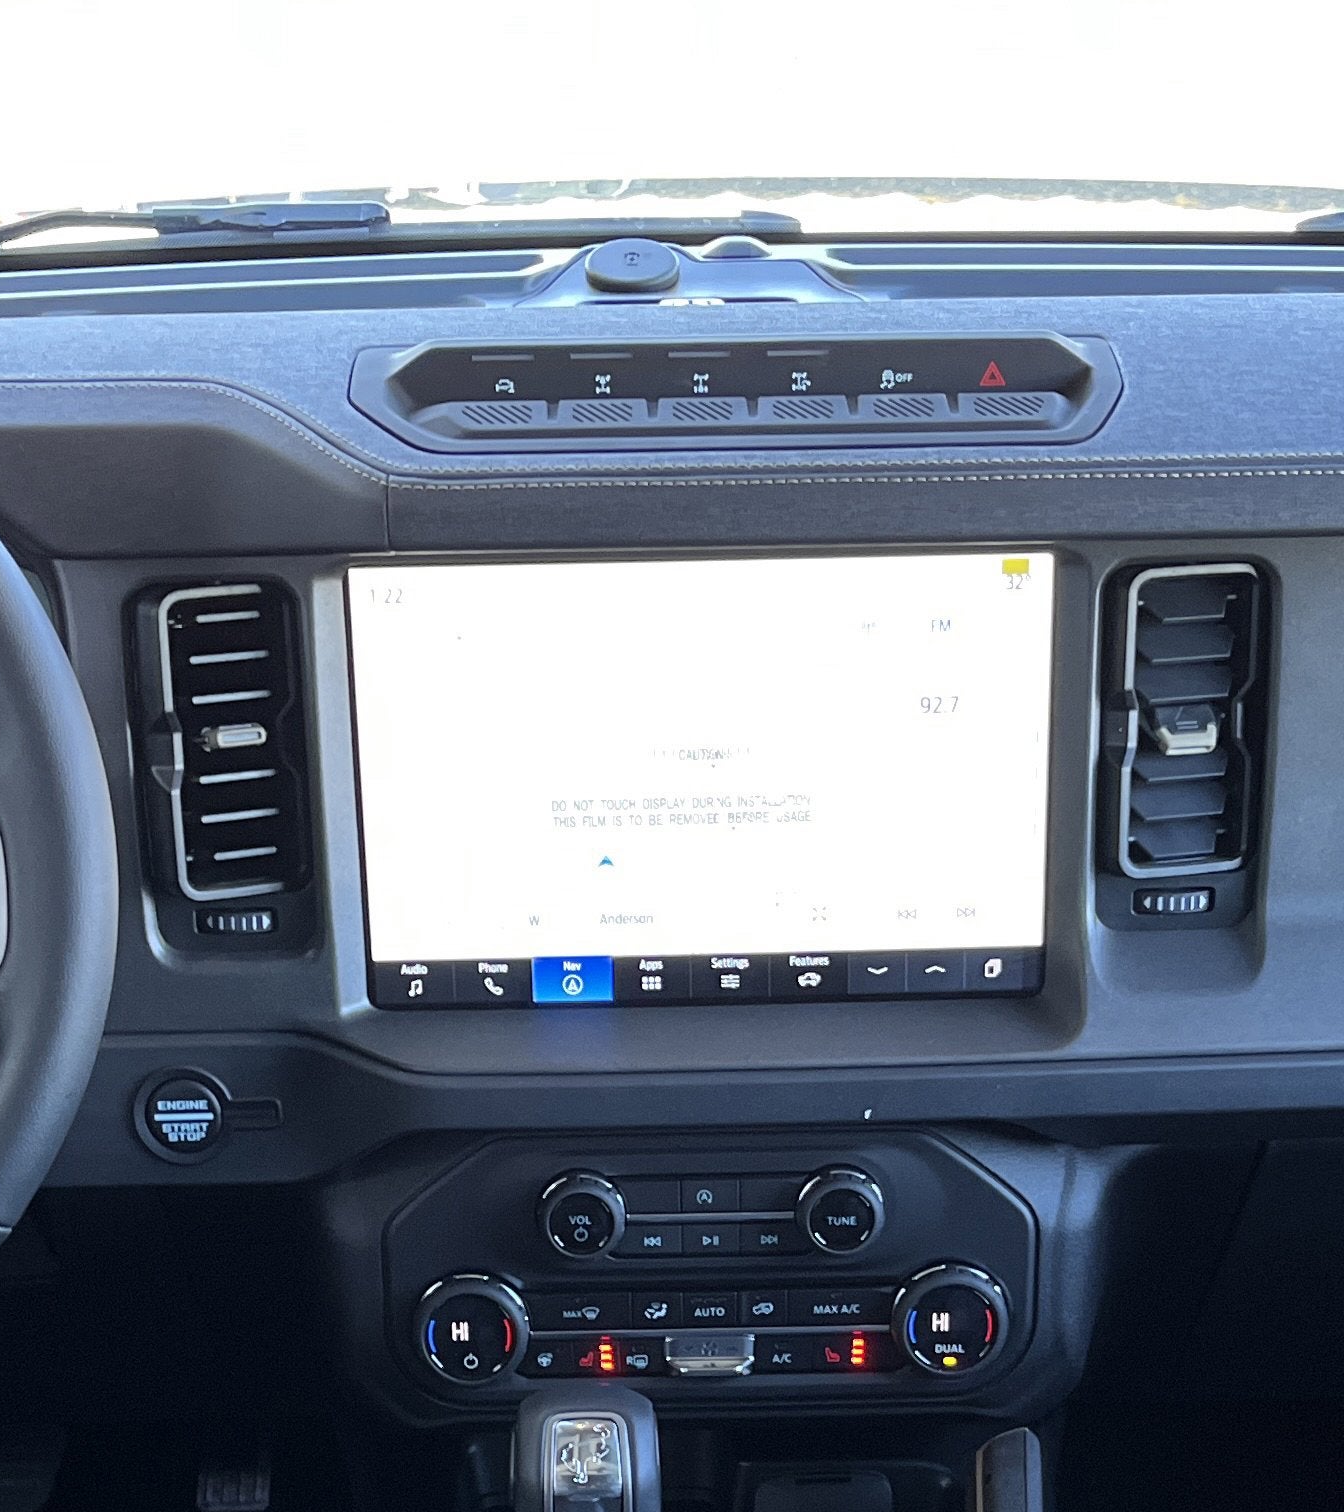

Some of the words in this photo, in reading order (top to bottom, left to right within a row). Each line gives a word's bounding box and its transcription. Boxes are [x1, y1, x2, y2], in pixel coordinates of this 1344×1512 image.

[895, 372, 913, 382] OFF
[931, 619, 951, 632] FM
[920, 696, 959, 714] 92.7
[551, 800, 567, 812] DO
[573, 799, 594, 811] NOT
[601, 799, 636, 810] TOUCH
[642, 798, 685, 810] DISPLAY
[553, 816, 576, 828] THIS
[582, 816, 606, 827] FILM
[612, 816, 623, 827] IS
[630, 815, 643, 826] TO
[649, 814, 663, 826] BE
[599, 913, 654, 925] Anderson
[563, 961, 581, 972] Nav
[639, 959, 664, 971] Apps
[710, 957, 750, 970] Settings
[789, 956, 830, 967] Features
[401, 964, 428, 975] Audio
[478, 962, 509, 973] Phone
[157, 1100, 209, 1111] ENGINE
[162, 1122, 209, 1133] START
[167, 1132, 206, 1142] STOP
[568, 1215, 592, 1226] VOL
[827, 1216, 858, 1227] TUNE
[562, 1310, 582, 1319] MAX
[694, 1306, 726, 1318] AUTO
[813, 1304, 838, 1315] MAX
[840, 1303, 861, 1315] A/C
[931, 1312, 950, 1332] HI
[451, 1321, 469, 1341] HI
[934, 1343, 965, 1354] DUAL
[772, 1352, 792, 1364] A/C
